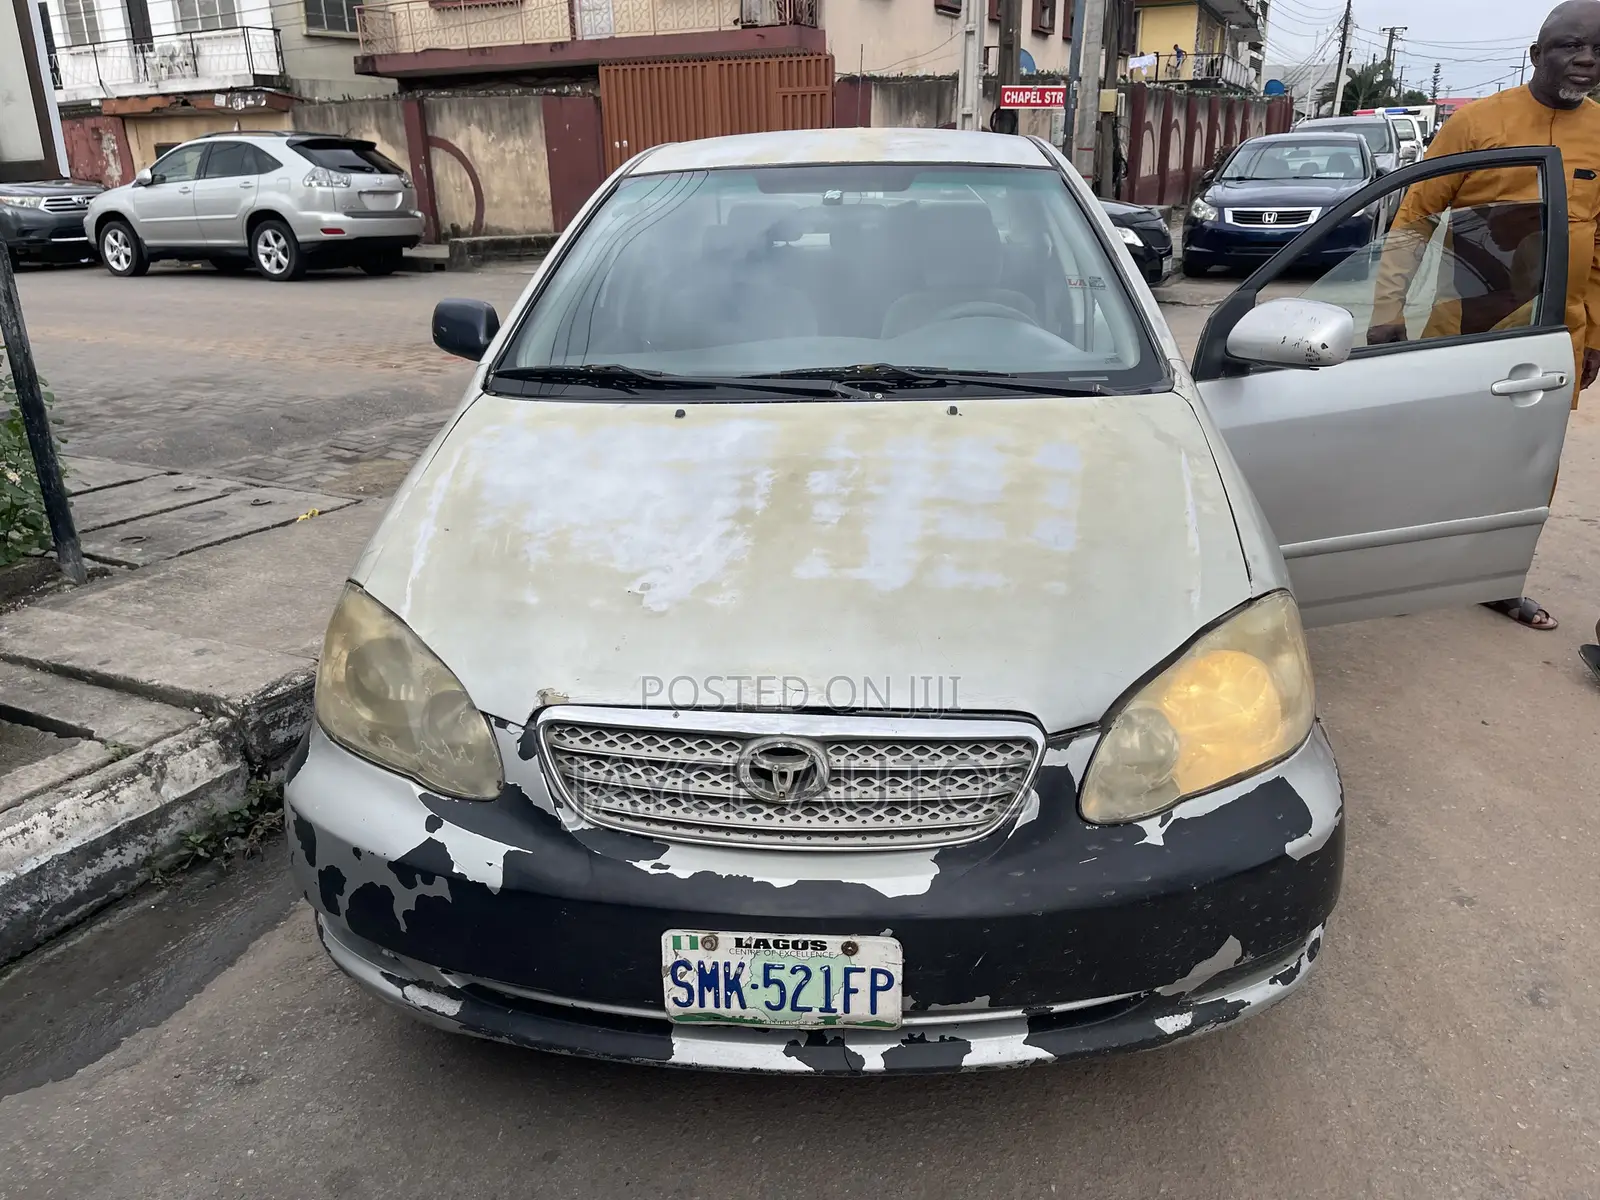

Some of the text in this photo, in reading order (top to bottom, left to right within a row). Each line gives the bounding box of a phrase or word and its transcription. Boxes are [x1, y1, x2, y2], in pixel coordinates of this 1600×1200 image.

[1004, 91, 1064, 103] CHAPEL STR
[734, 937, 828, 951] LAGOS
[728, 948, 834, 958] CENTRE OF EXCELLENCE
